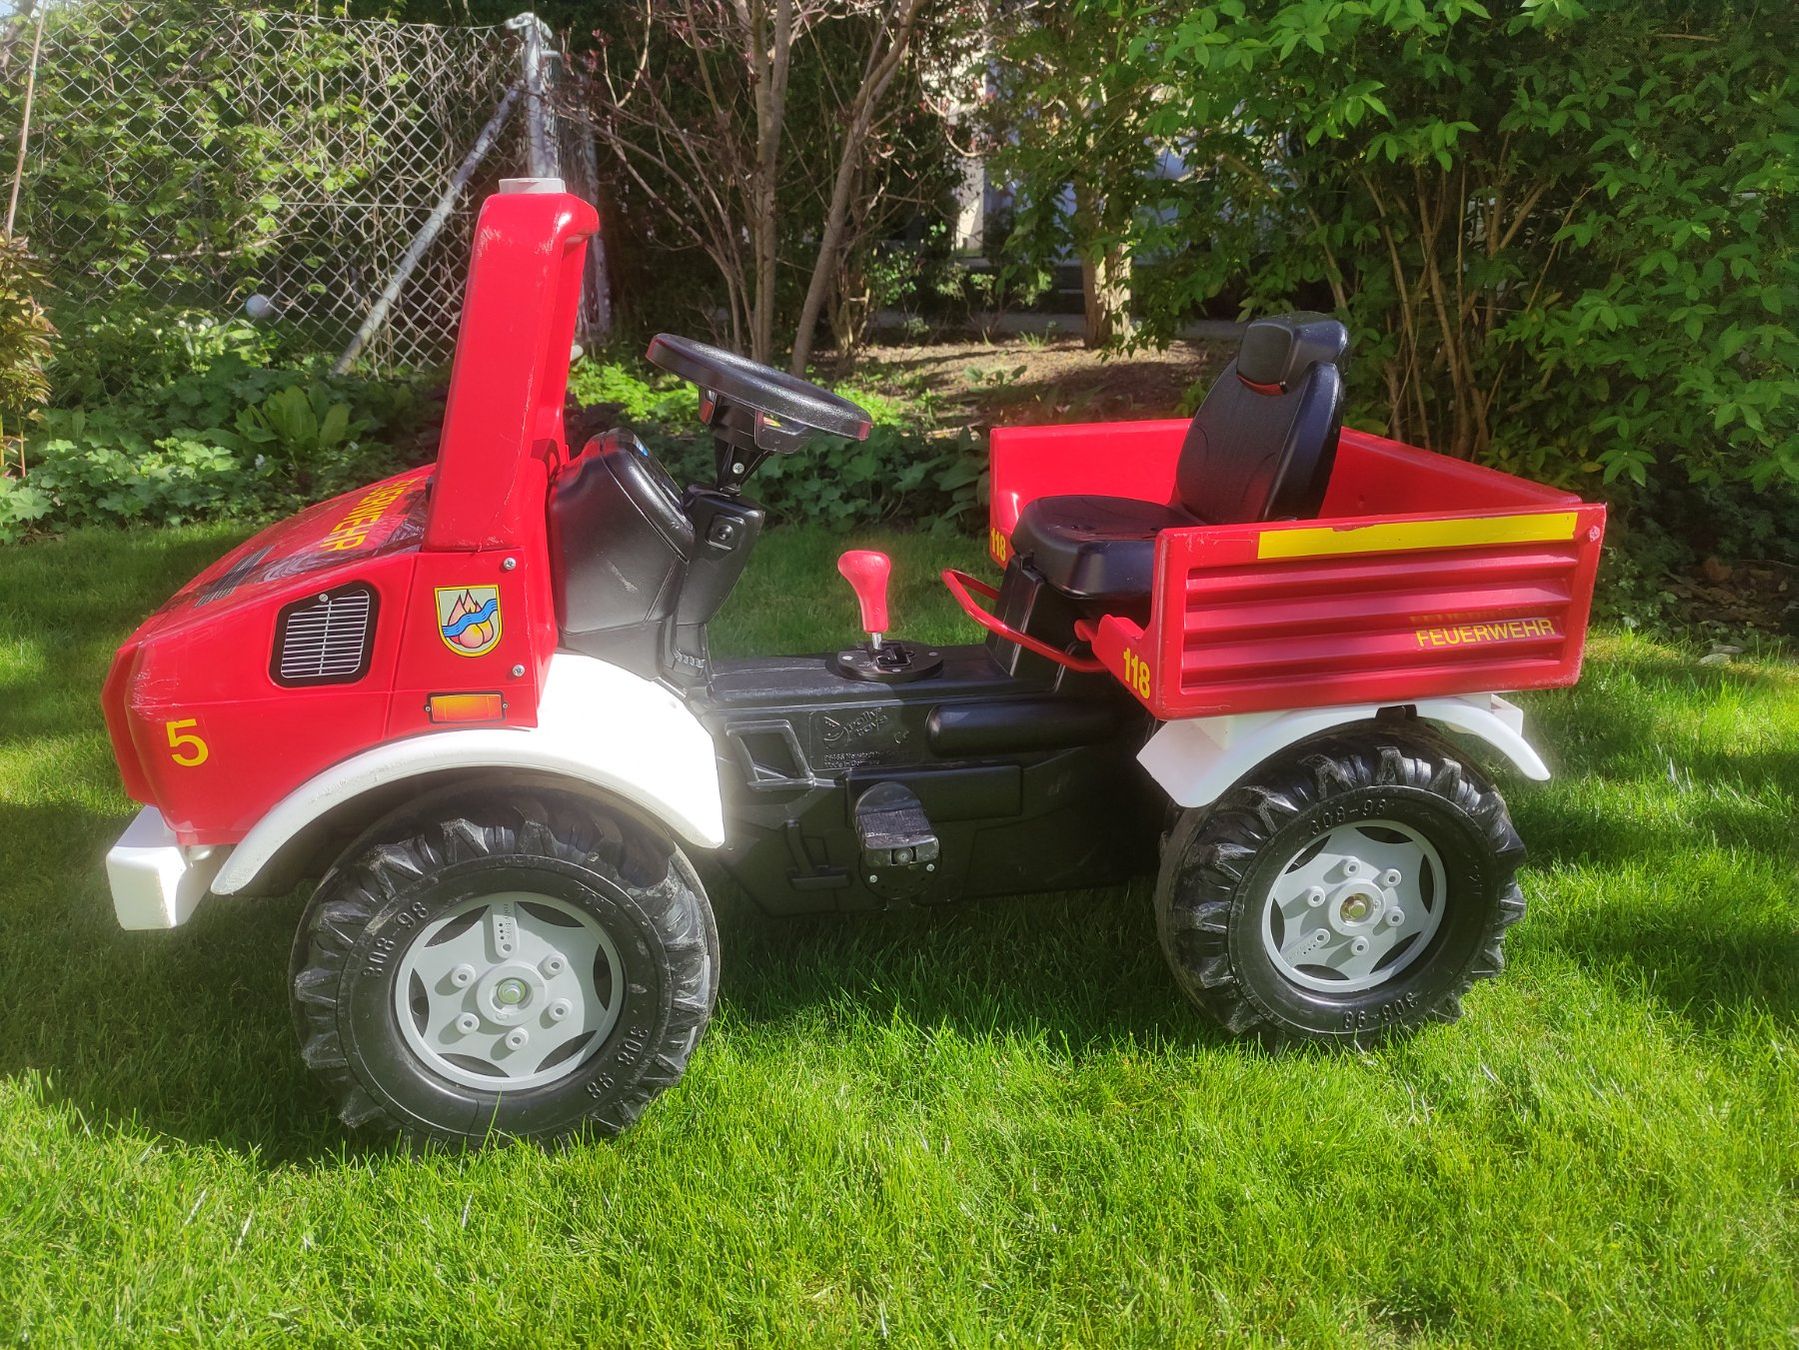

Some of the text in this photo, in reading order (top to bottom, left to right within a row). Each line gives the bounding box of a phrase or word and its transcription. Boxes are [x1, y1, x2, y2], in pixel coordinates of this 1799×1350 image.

[990, 528, 1006, 562] 118
[1415, 619, 1556, 647] FEUERWEHR
[1123, 648, 1150, 699] 118
[166, 718, 209, 767] 5
